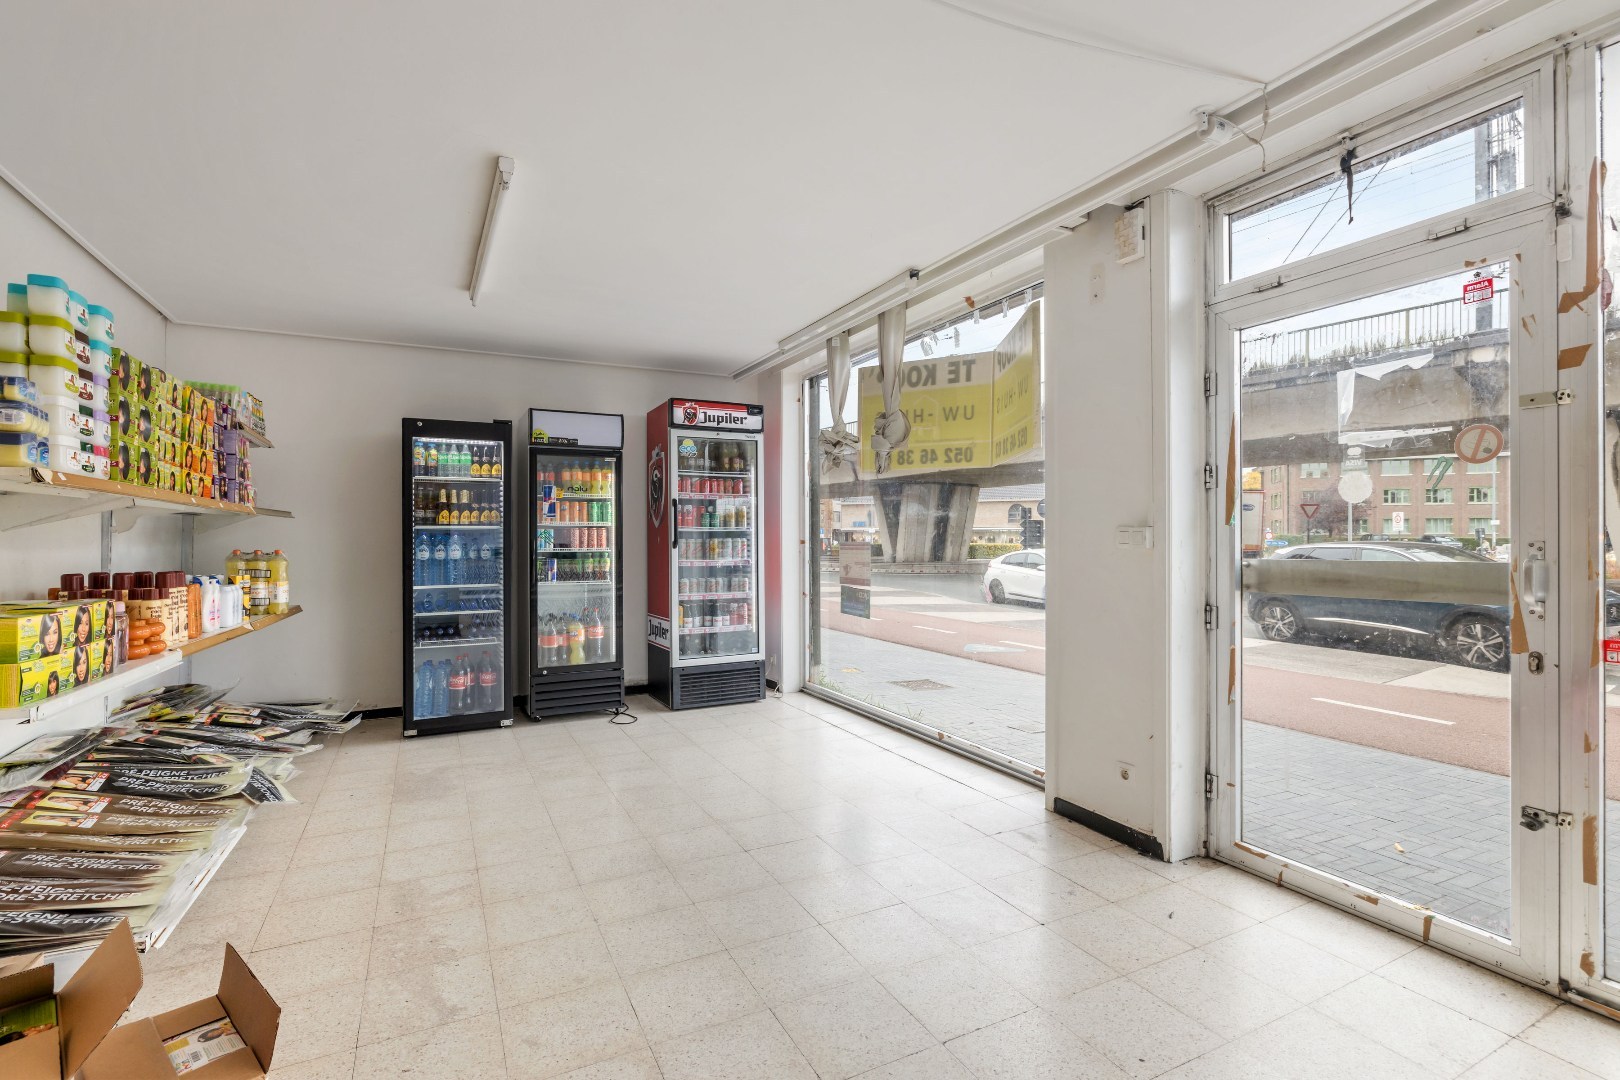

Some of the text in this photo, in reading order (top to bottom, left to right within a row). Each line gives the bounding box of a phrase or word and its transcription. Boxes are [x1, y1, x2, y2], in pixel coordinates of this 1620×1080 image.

[700, 411, 748, 427] Jupiler
[679, 445, 697, 453] eco
[567, 486, 588, 494] nalu
[648, 619, 669, 641] Jupiler
